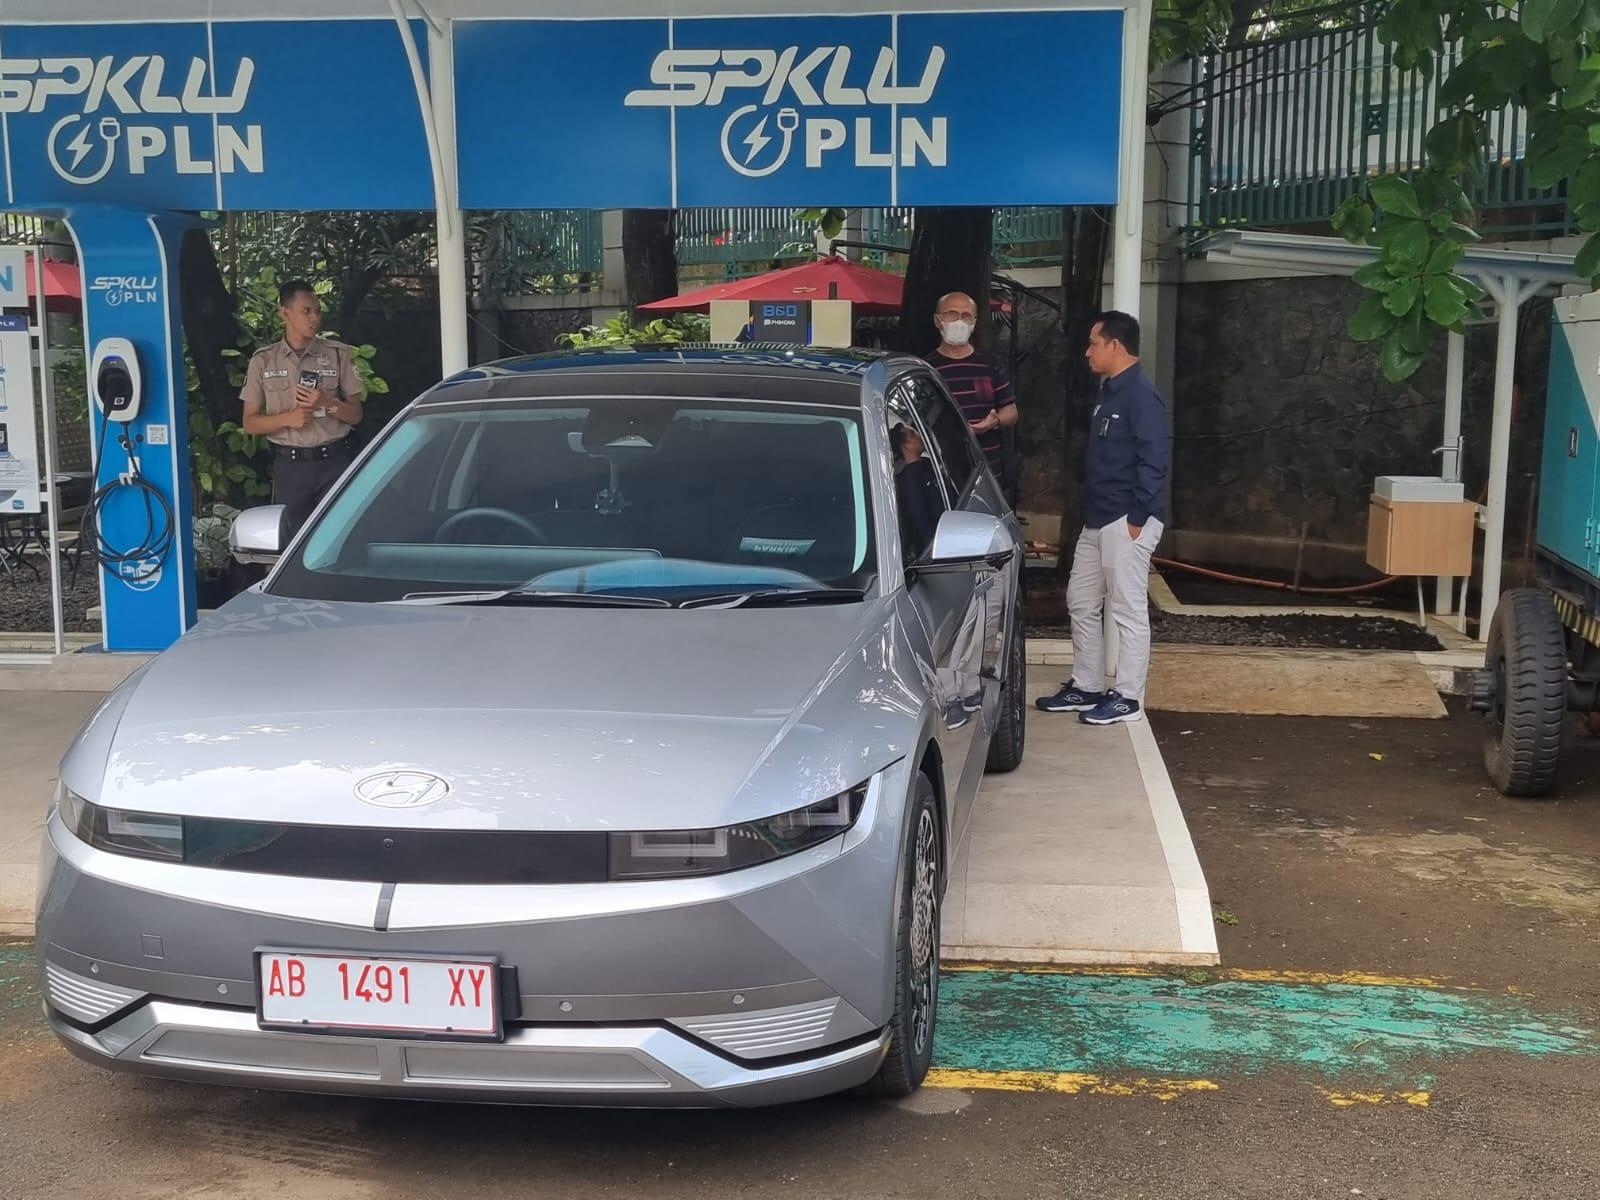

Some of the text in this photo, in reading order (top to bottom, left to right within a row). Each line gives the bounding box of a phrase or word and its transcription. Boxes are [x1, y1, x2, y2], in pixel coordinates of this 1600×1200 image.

[624, 45, 946, 106] SPKLU
[127, 124, 265, 175] PLN
[806, 117, 948, 168] PLN
[89, 276, 157, 290] SPKLU
[124, 291, 157, 303] PLN
[268, 958, 485, 1007] AB 1491 XY
